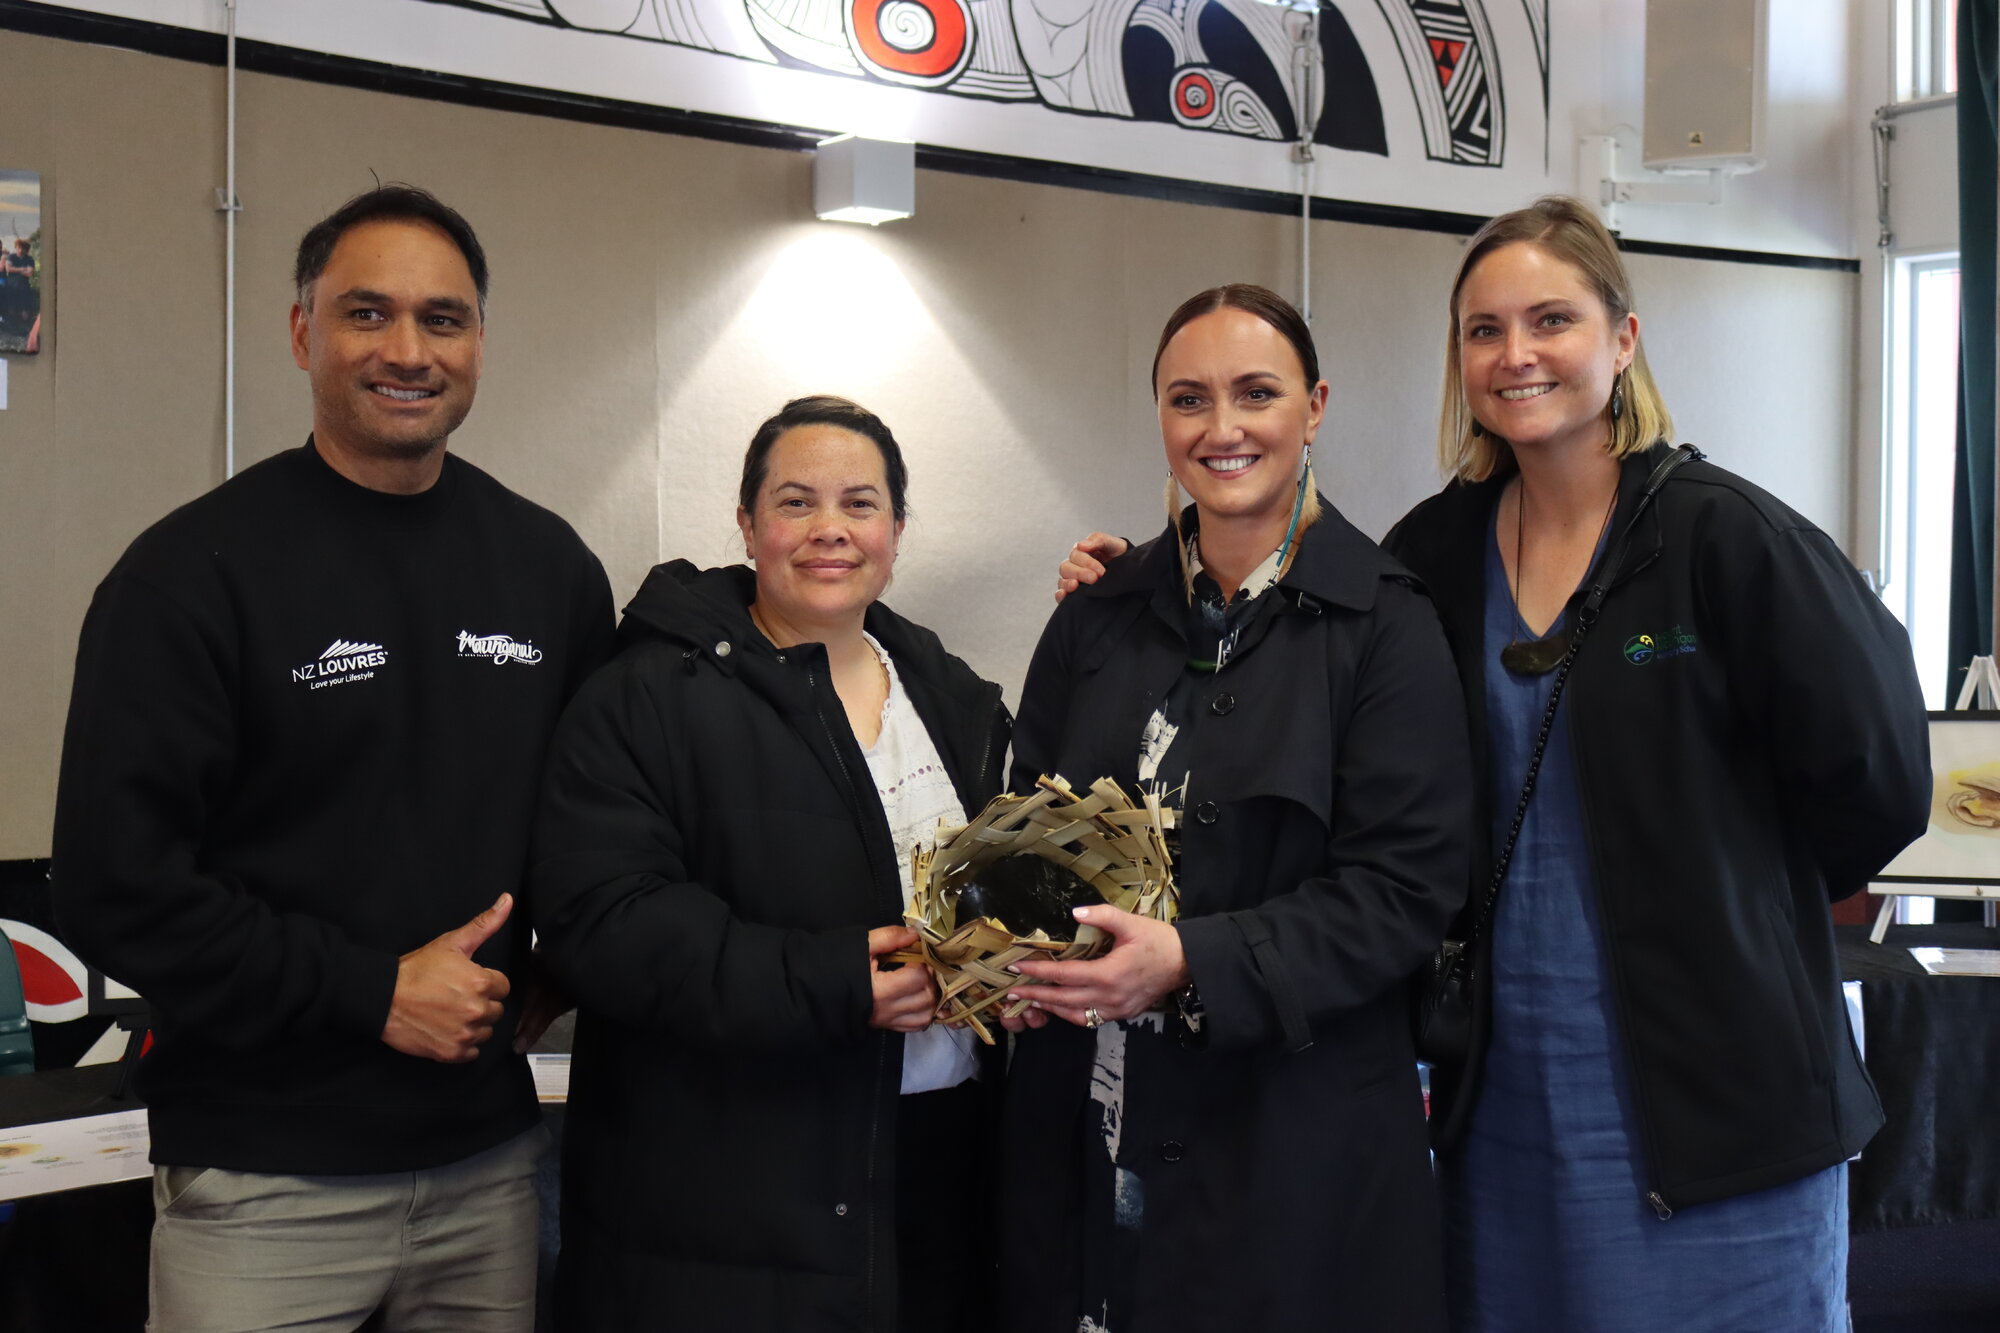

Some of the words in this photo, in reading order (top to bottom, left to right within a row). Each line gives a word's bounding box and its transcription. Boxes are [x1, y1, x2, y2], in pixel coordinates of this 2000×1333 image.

[456, 630, 542, 665] Maunganui
[292, 664, 316, 683] NZ
[318, 652, 386, 676] LOUVRES
[310, 680, 328, 690] Love
[328, 677, 345, 687] your
[345, 671, 375, 683] Lifestyle
